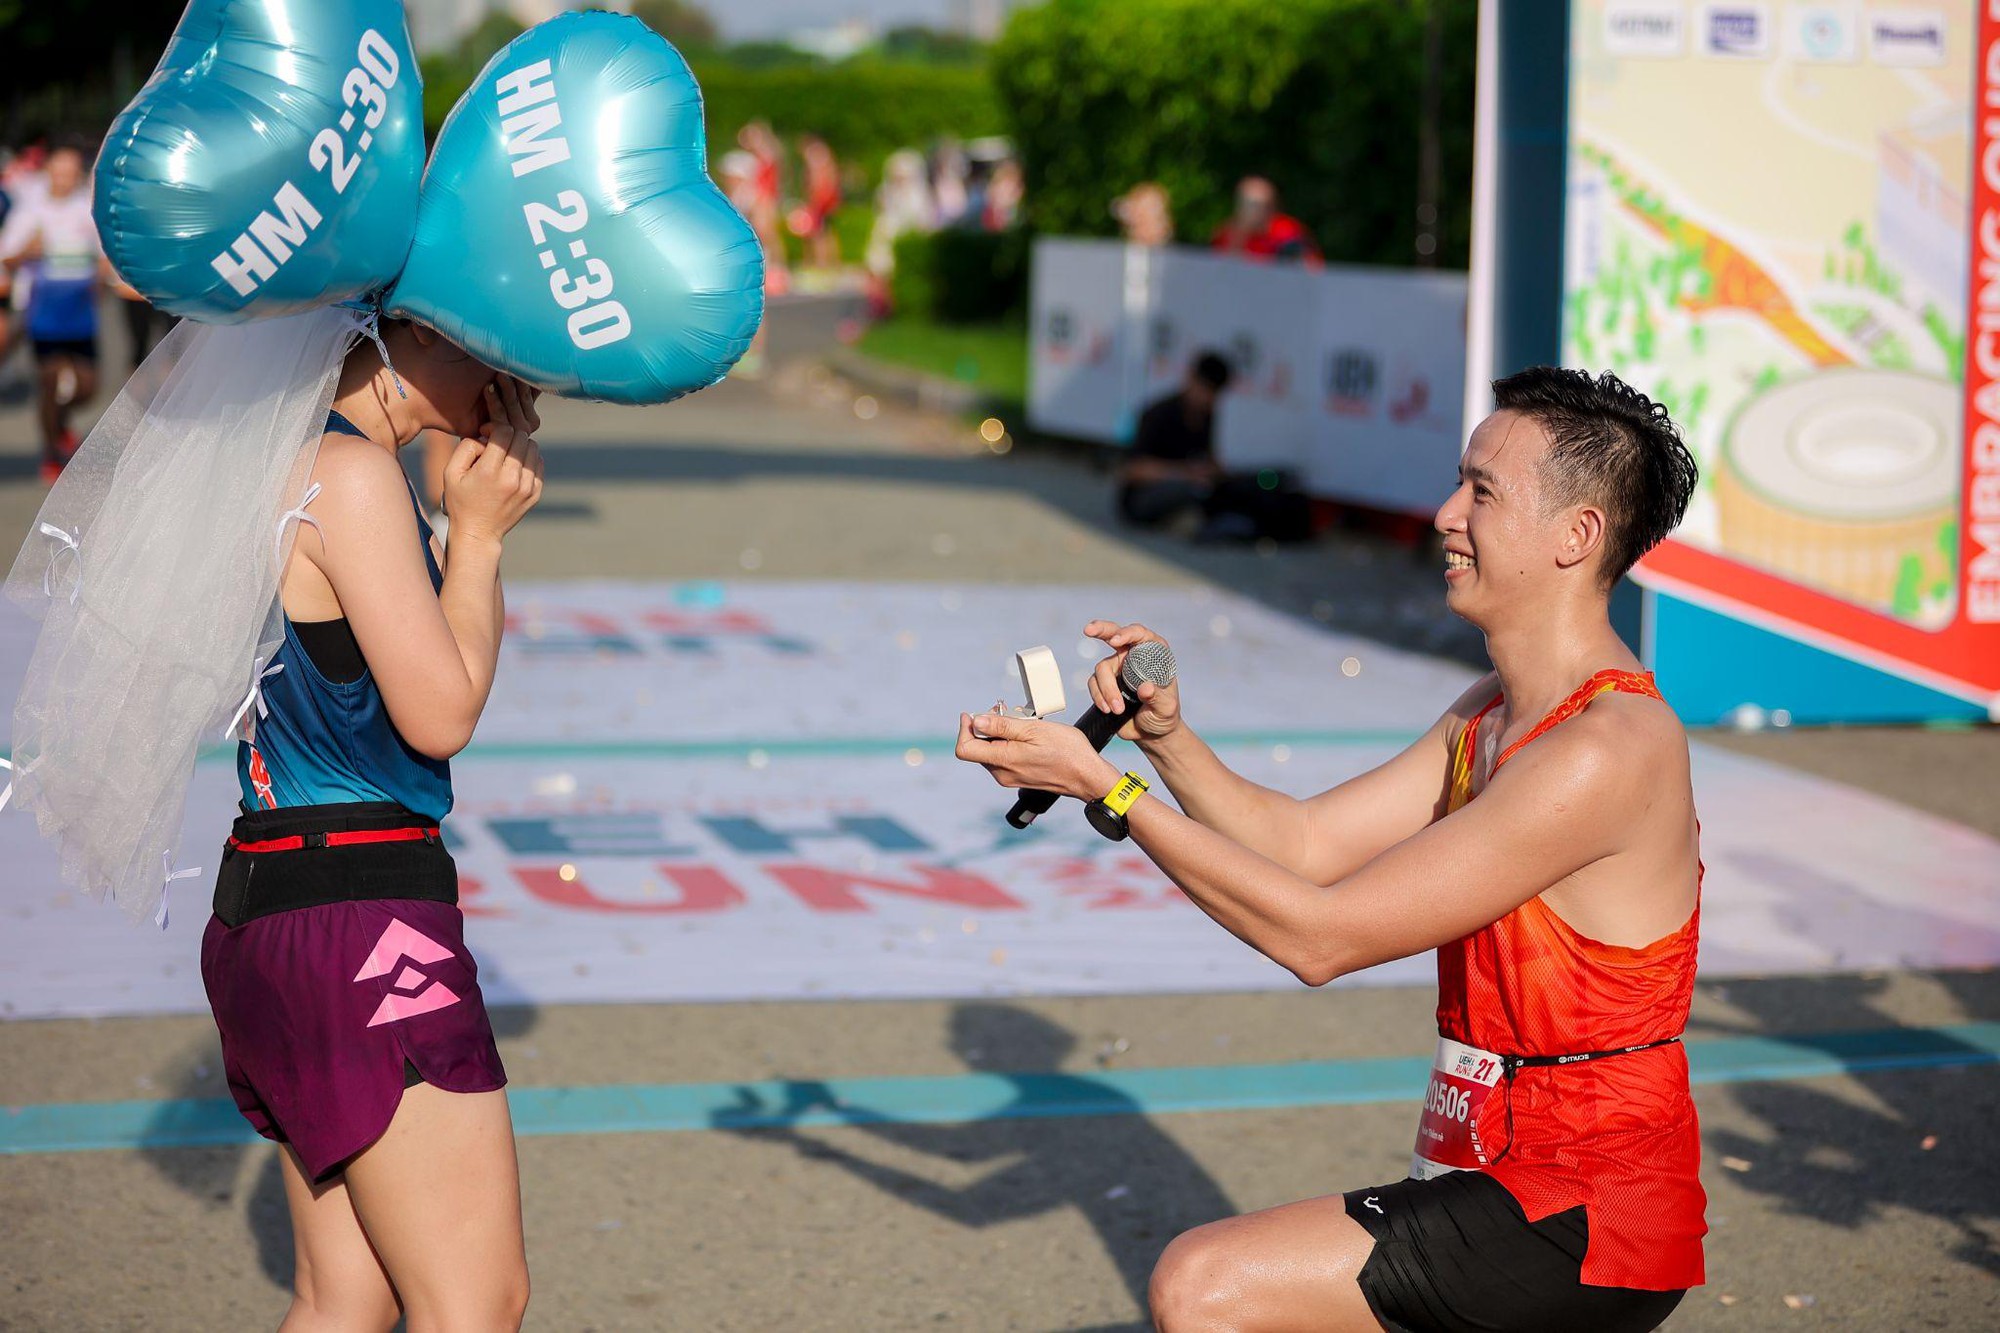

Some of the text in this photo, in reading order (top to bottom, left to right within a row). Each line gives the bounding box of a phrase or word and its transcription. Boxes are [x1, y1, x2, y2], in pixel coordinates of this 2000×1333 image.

[210, 28, 400, 297] HM 2:30
[496, 58, 632, 350] HM 2:30
[442, 816, 936, 855] EH
[1473, 1058, 1496, 1082] 21
